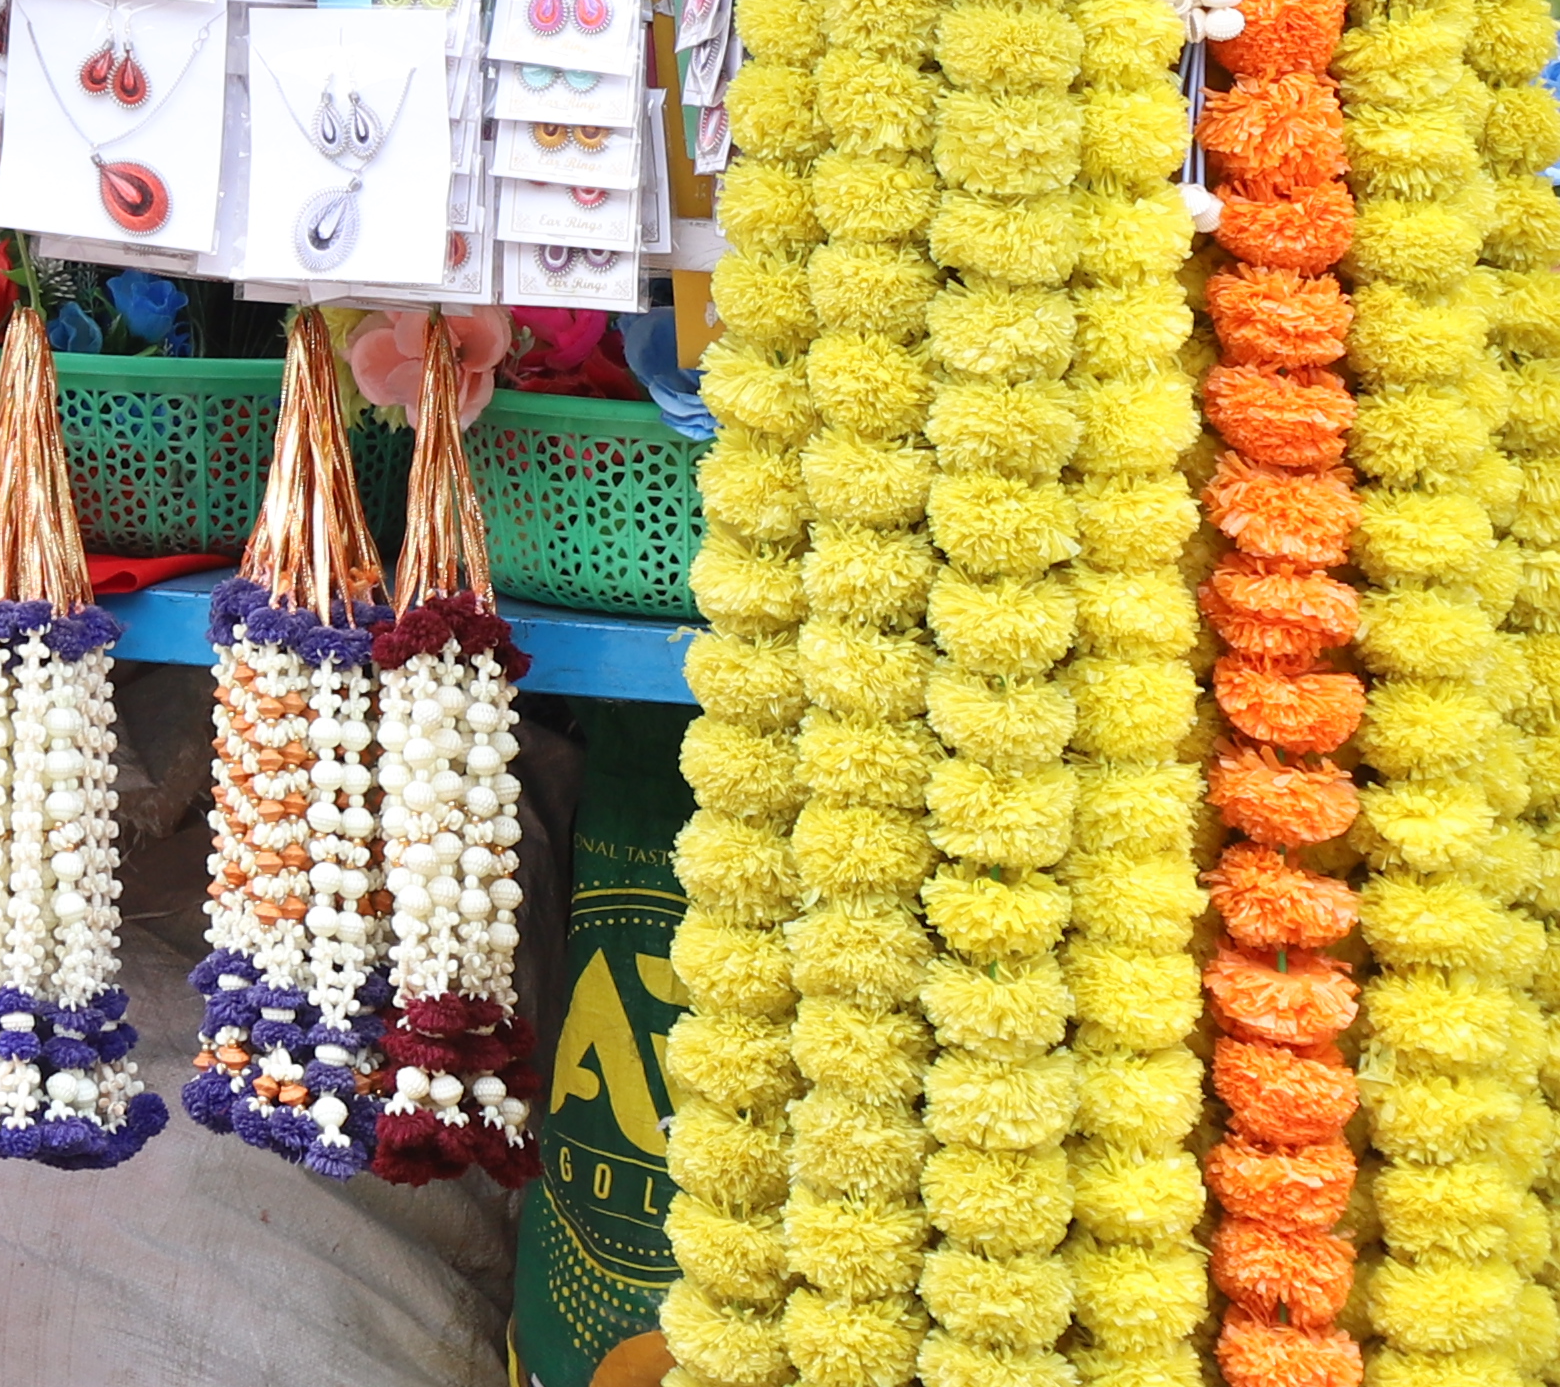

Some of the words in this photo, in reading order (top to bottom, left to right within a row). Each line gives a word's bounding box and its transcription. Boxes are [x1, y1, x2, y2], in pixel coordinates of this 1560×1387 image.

[538, 214, 562, 226] Ear
[566, 215, 603, 231] Rings
[545, 275, 568, 288] Ear
[572, 275, 608, 291] Rings
[625, 845, 668, 865] TAST
[558, 1145, 659, 1215] GOL
